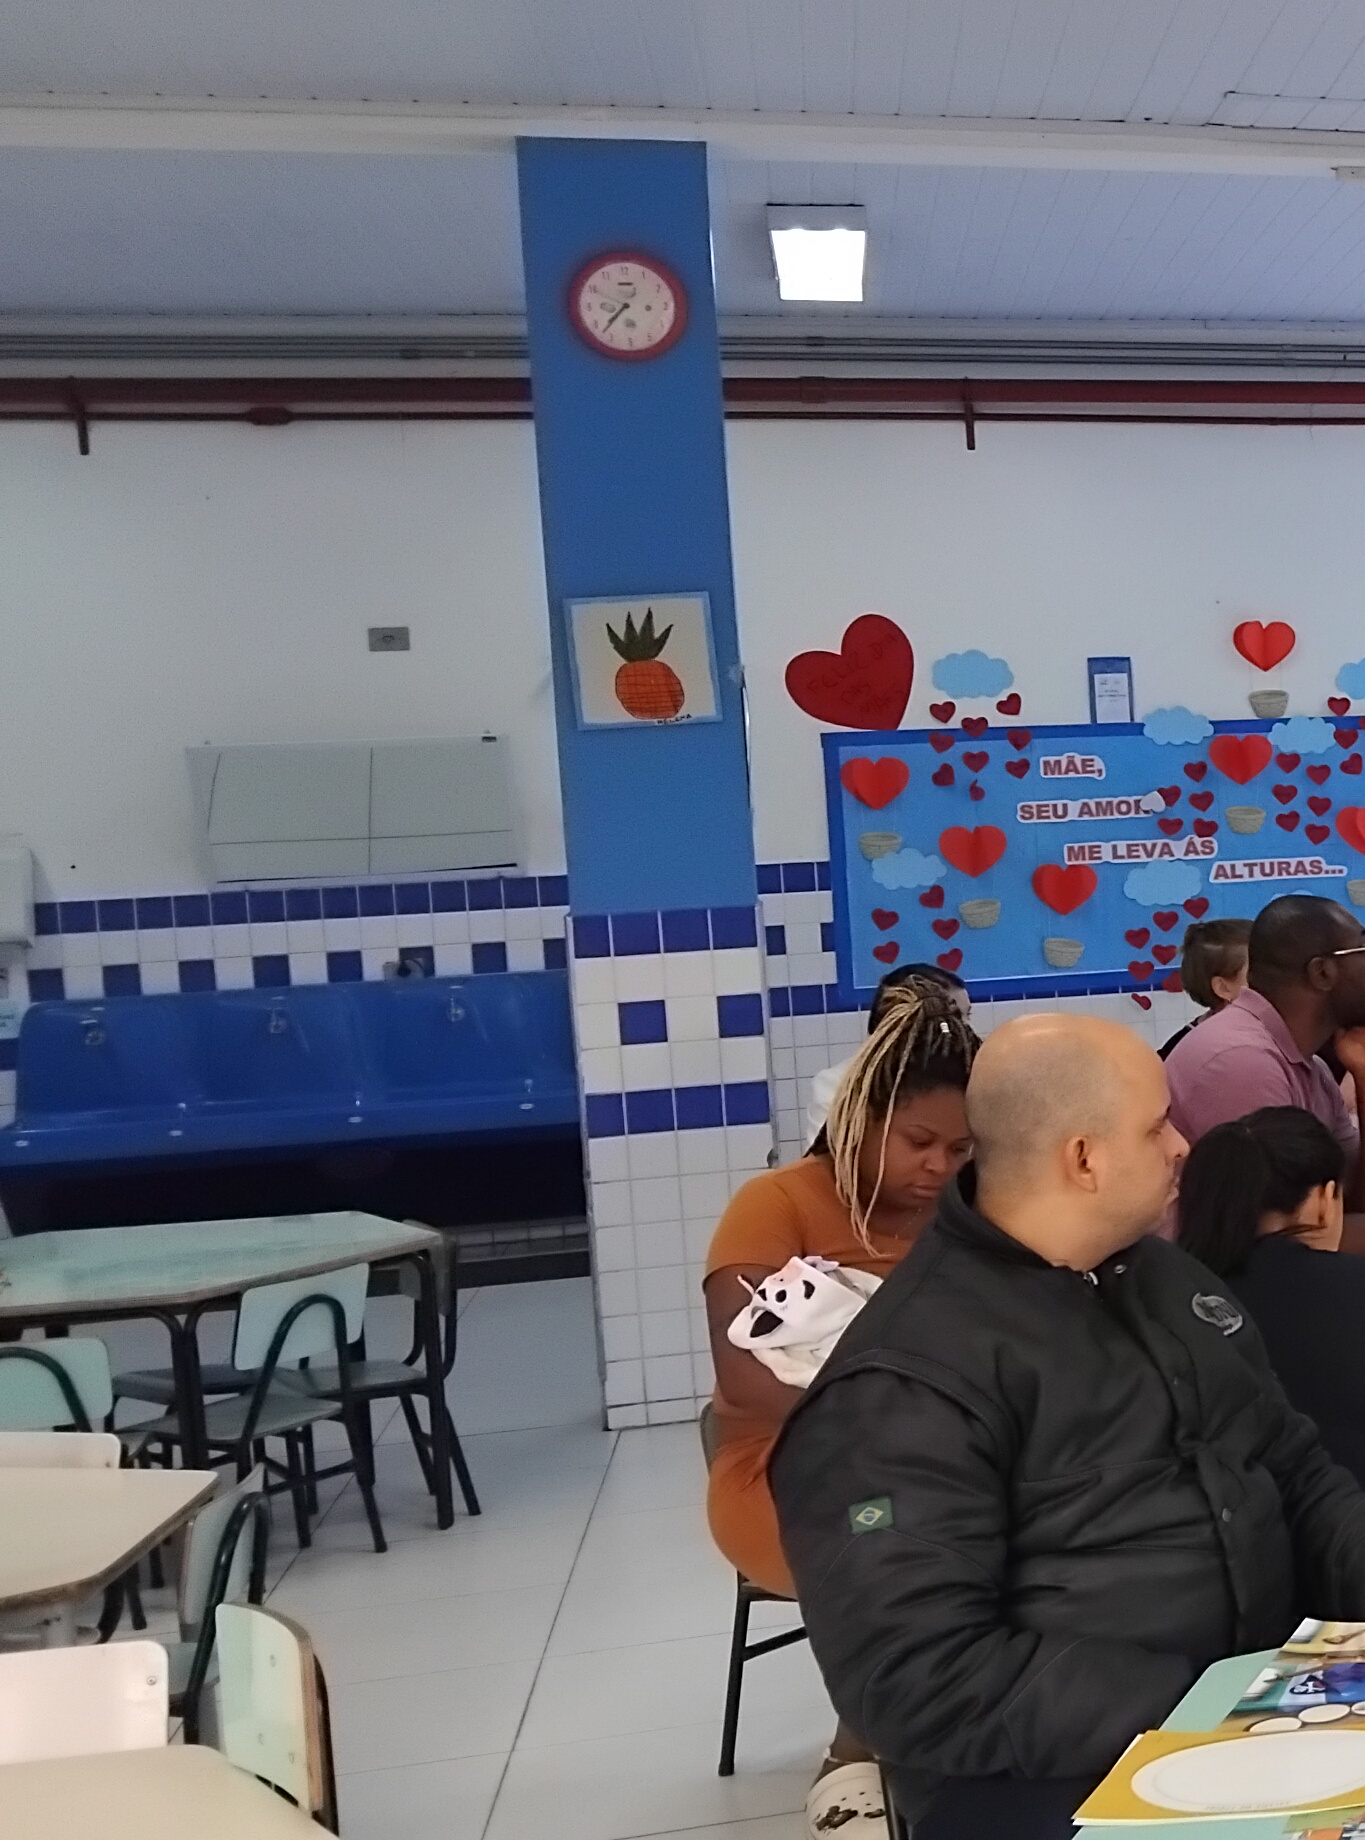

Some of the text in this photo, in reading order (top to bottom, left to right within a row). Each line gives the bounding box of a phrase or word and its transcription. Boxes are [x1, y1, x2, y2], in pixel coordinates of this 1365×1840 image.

[1042, 755, 1103, 777] MÃE,
[1019, 803, 1068, 821] SEU
[1066, 836, 1215, 862] ME LEVA ÁS
[1213, 859, 1344, 880] ALTURAS...
